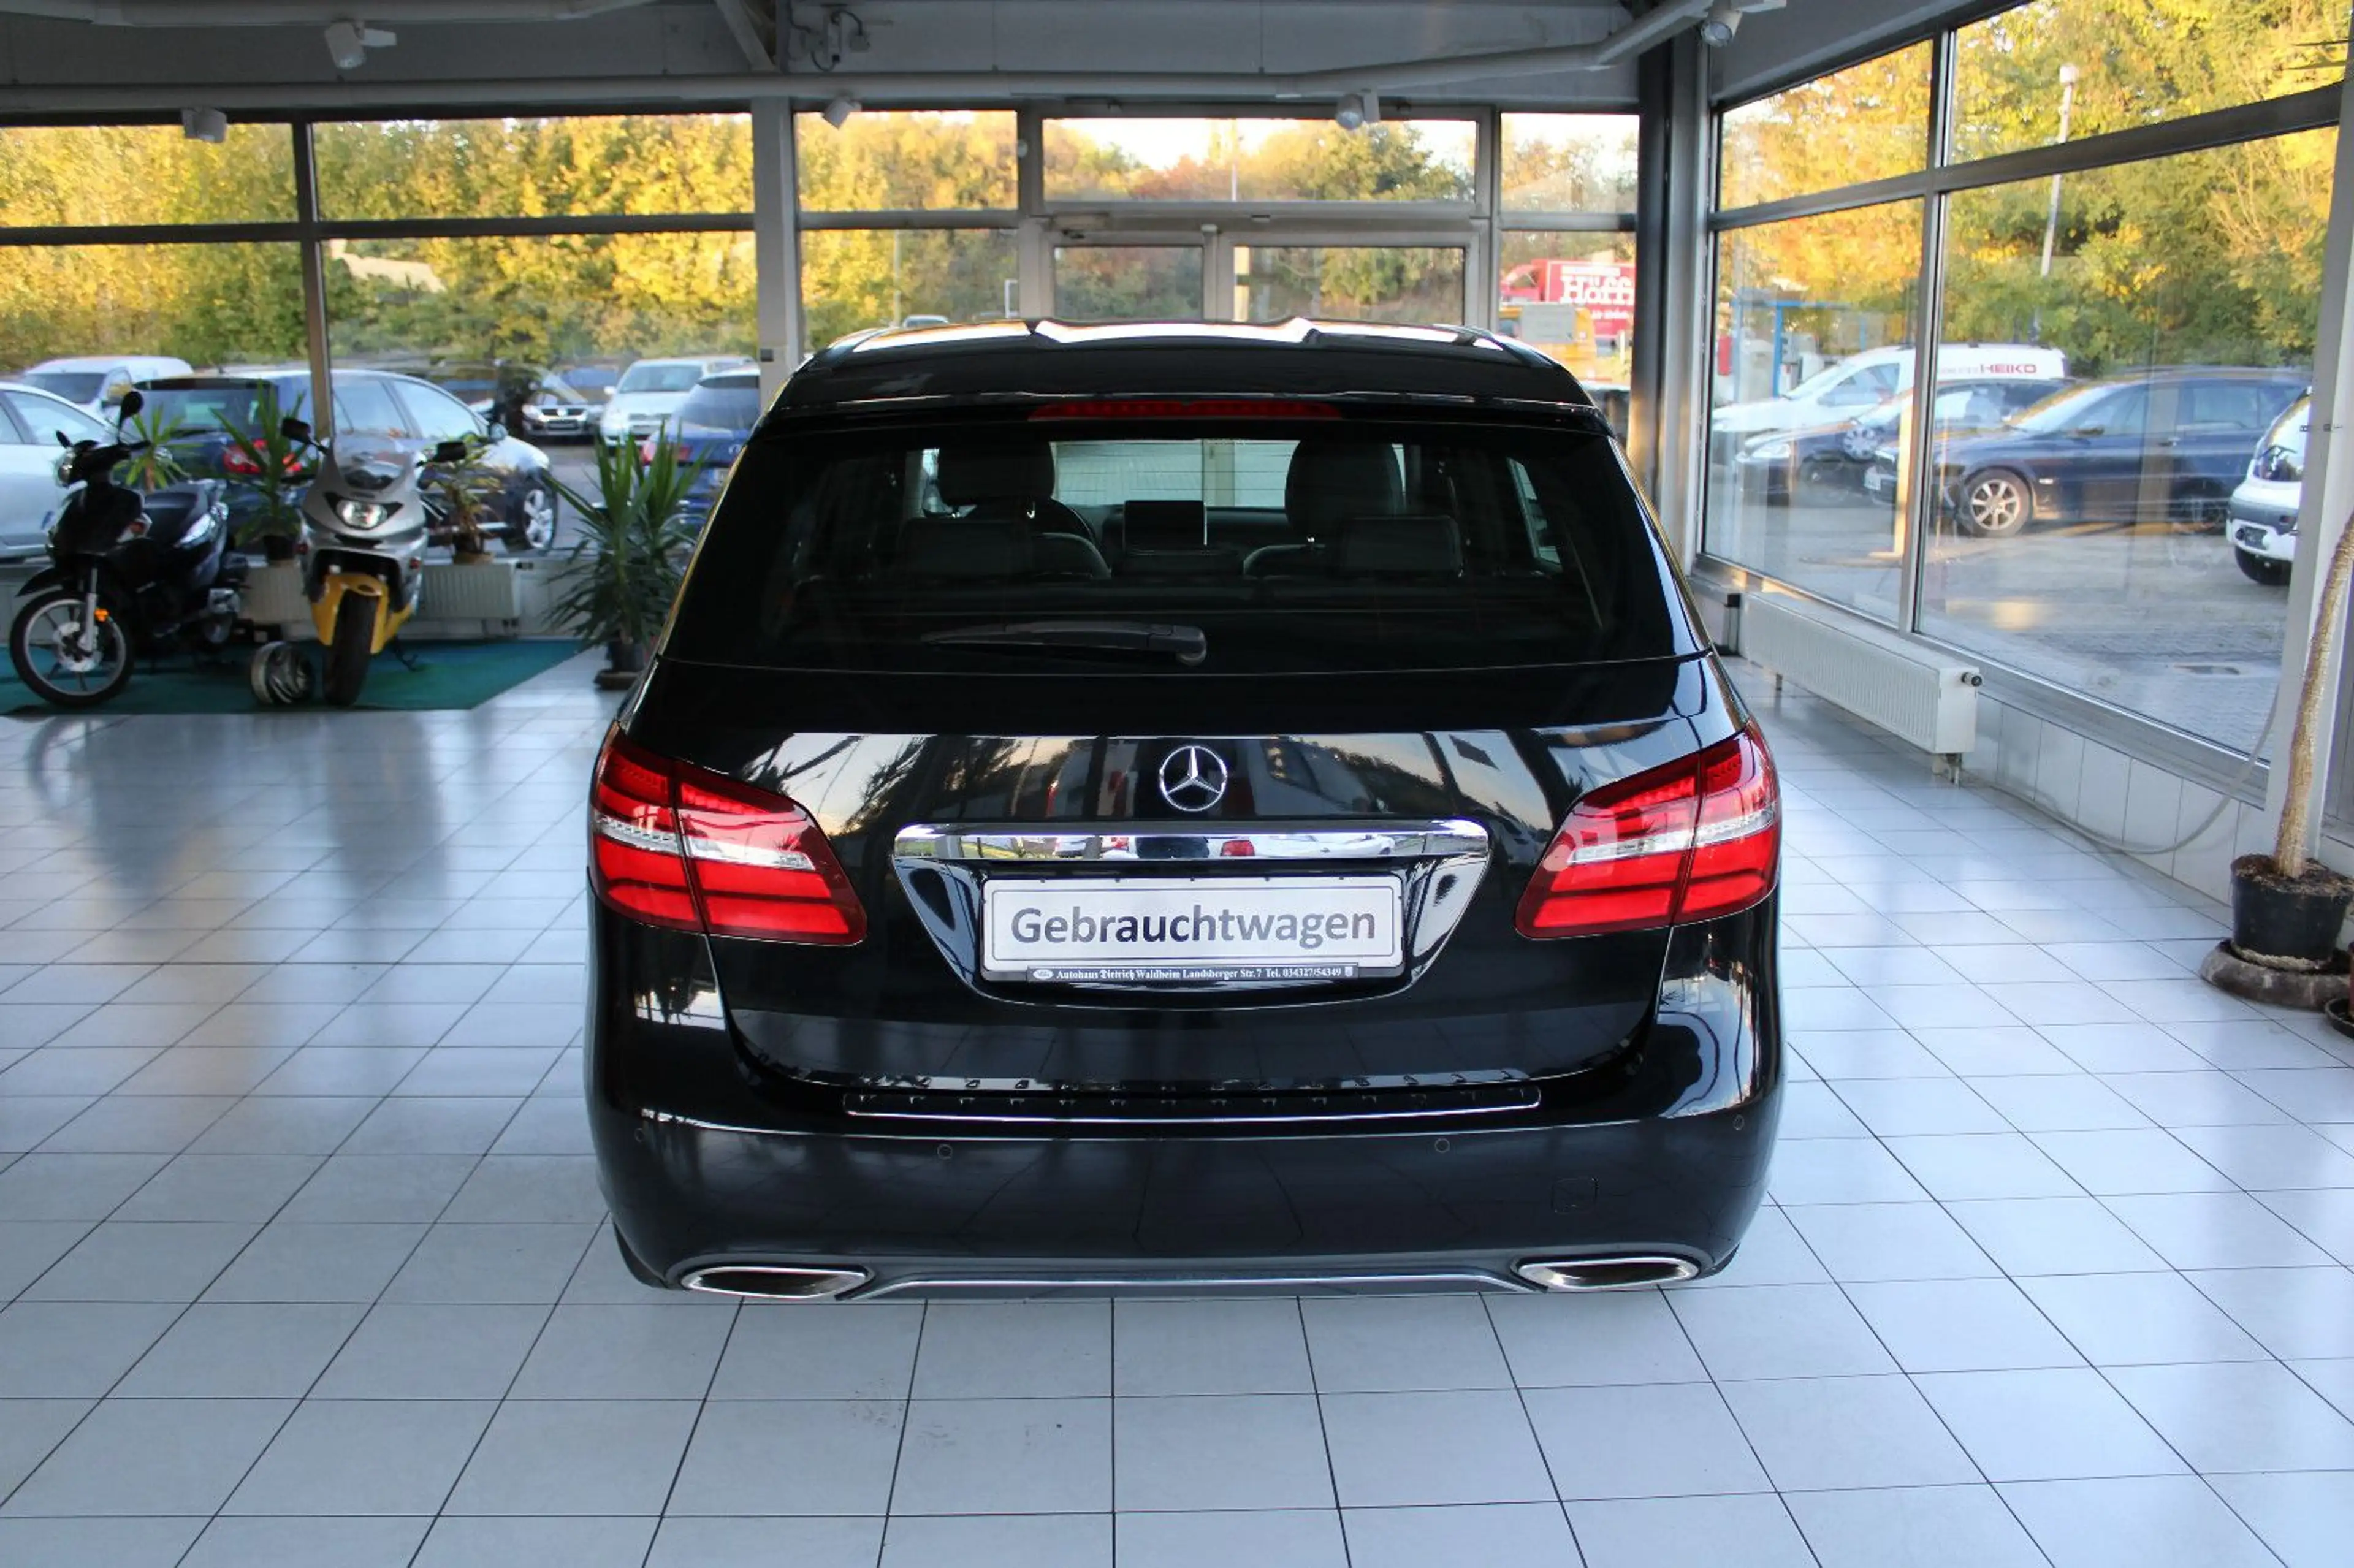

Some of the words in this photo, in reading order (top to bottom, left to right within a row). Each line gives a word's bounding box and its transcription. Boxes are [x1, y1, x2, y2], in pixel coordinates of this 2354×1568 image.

[1980, 363, 2037, 374] HEIKO
[1011, 905, 1375, 948] Gebrauchtwagen
[1056, 969, 1098, 980] Autohaus
[1100, 969, 1135, 980] Dietrich
[1135, 969, 1181, 978] Waldheim
[1183, 968, 1237, 980] Landsberger
[1265, 967, 1280, 977] Tel.
